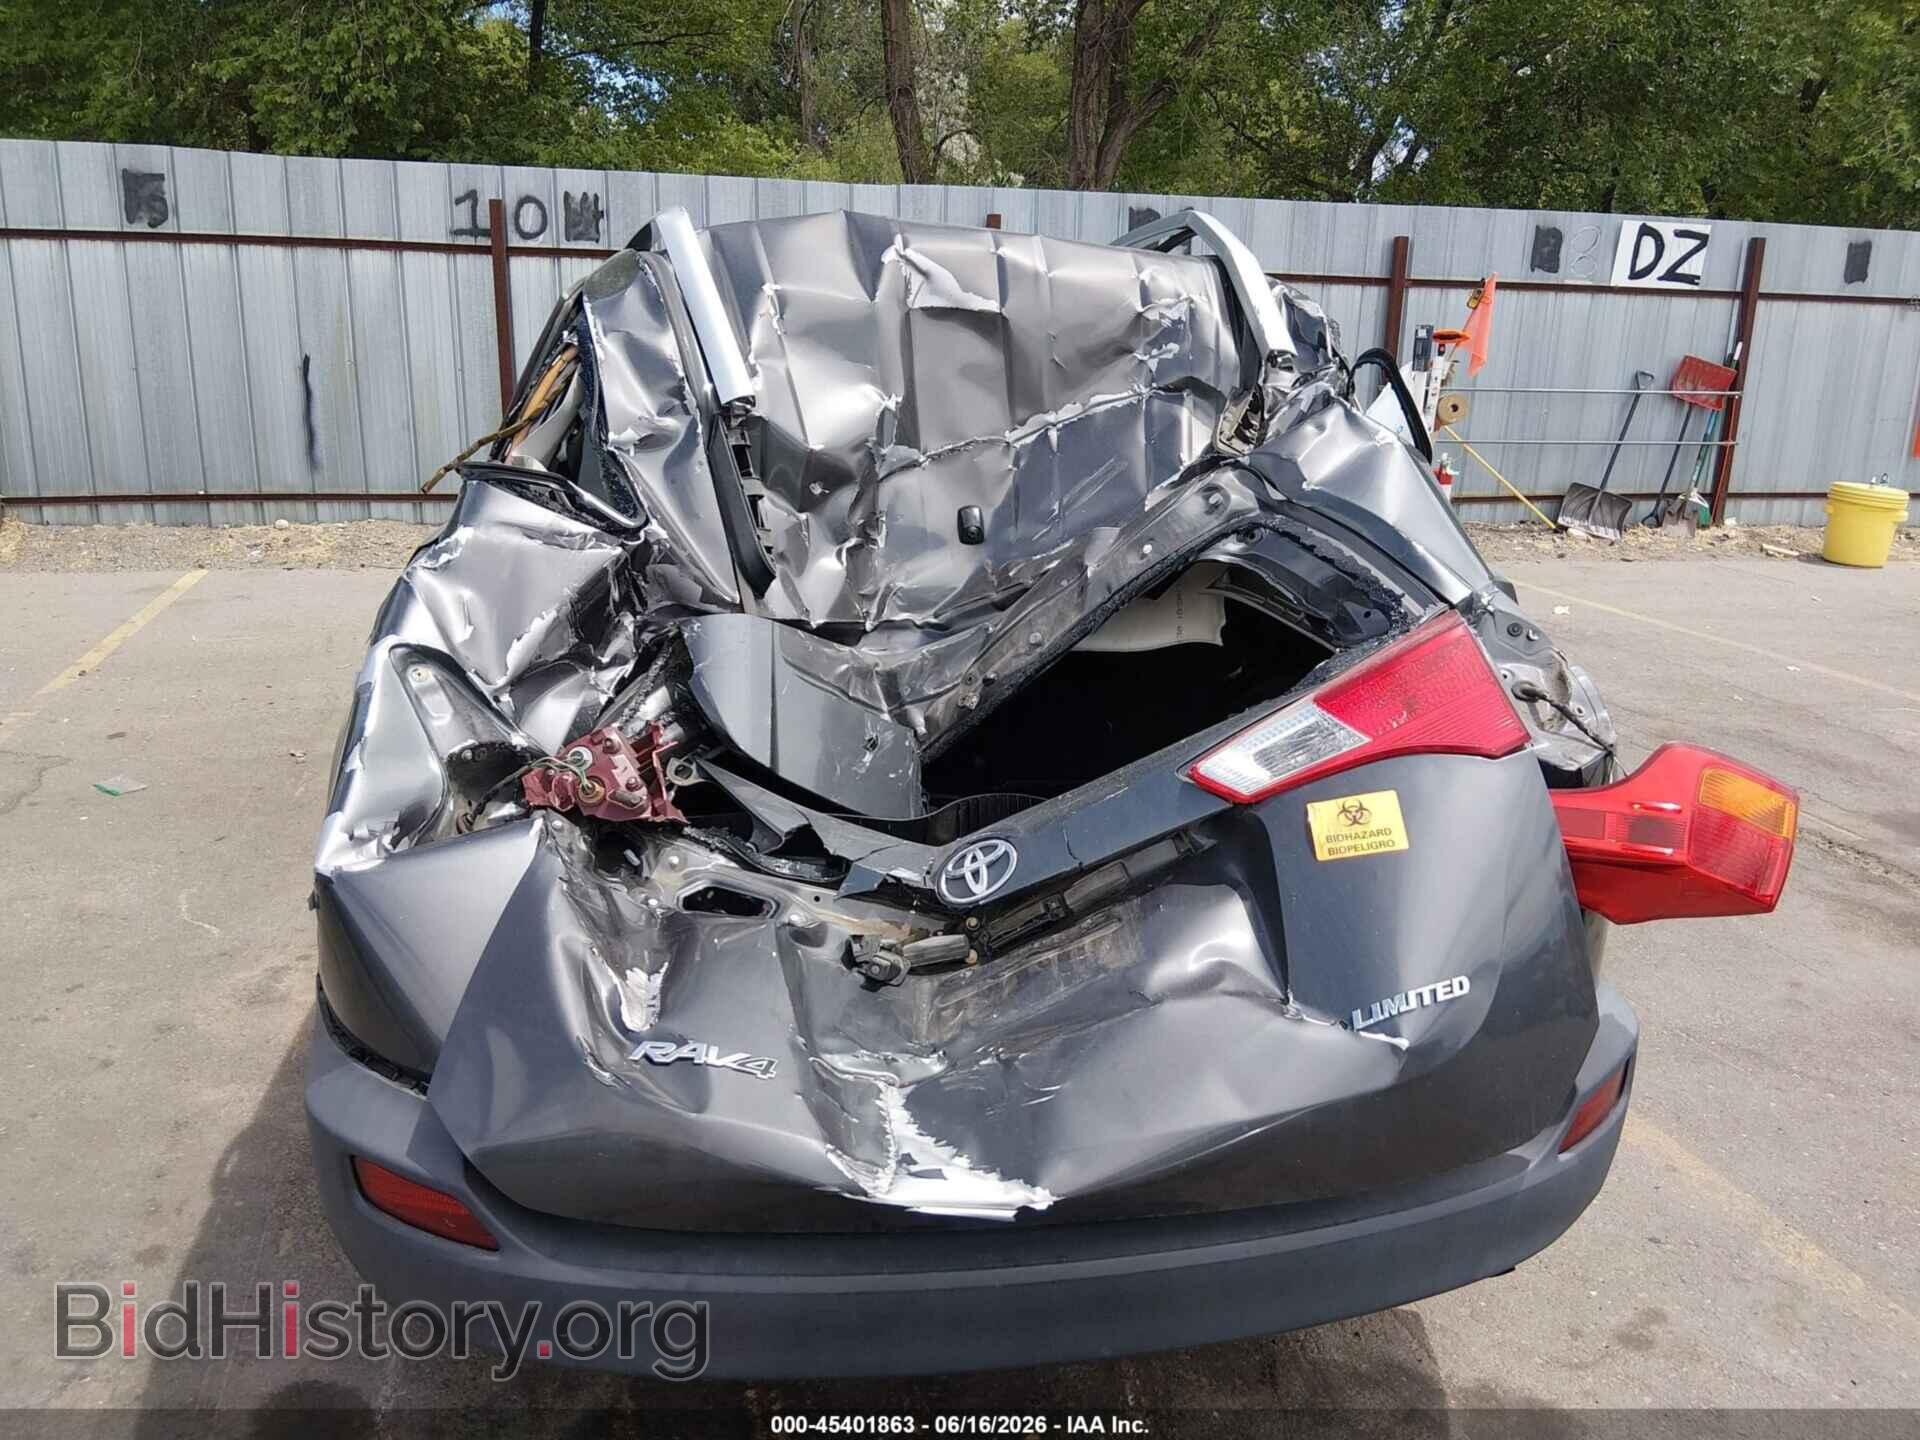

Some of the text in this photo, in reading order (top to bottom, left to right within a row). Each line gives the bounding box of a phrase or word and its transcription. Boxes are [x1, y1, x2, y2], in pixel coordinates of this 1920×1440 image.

[1326, 827, 1392, 843] BIOHAZARD
[1328, 839, 1395, 856] BIOPELIGRO
[1352, 975, 1470, 1031] LIMITED
[629, 1040, 778, 1079] RAV4
